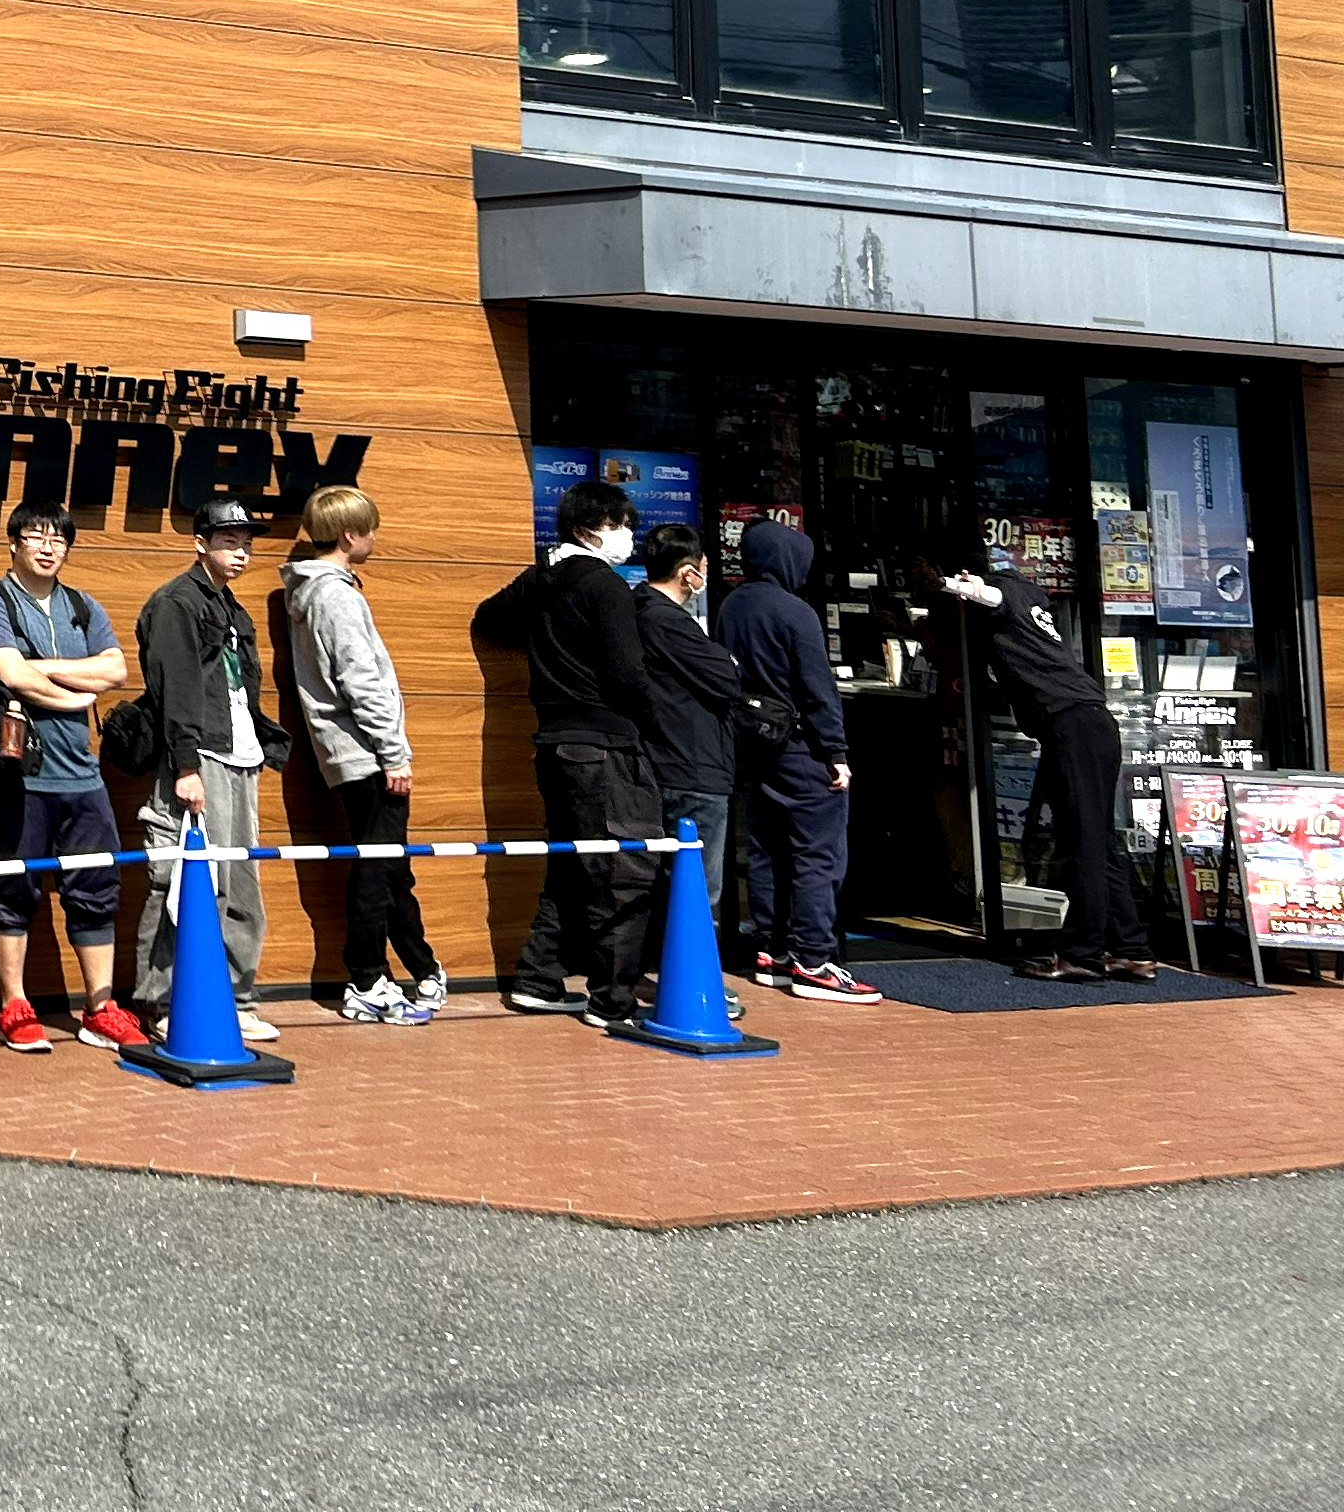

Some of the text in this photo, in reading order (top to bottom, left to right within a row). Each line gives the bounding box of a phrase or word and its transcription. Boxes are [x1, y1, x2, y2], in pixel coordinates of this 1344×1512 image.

[169, 368, 304, 420] Eight
[1153, 696, 1237, 724] Annex
[1255, 880, 1342, 911] 周年祭
